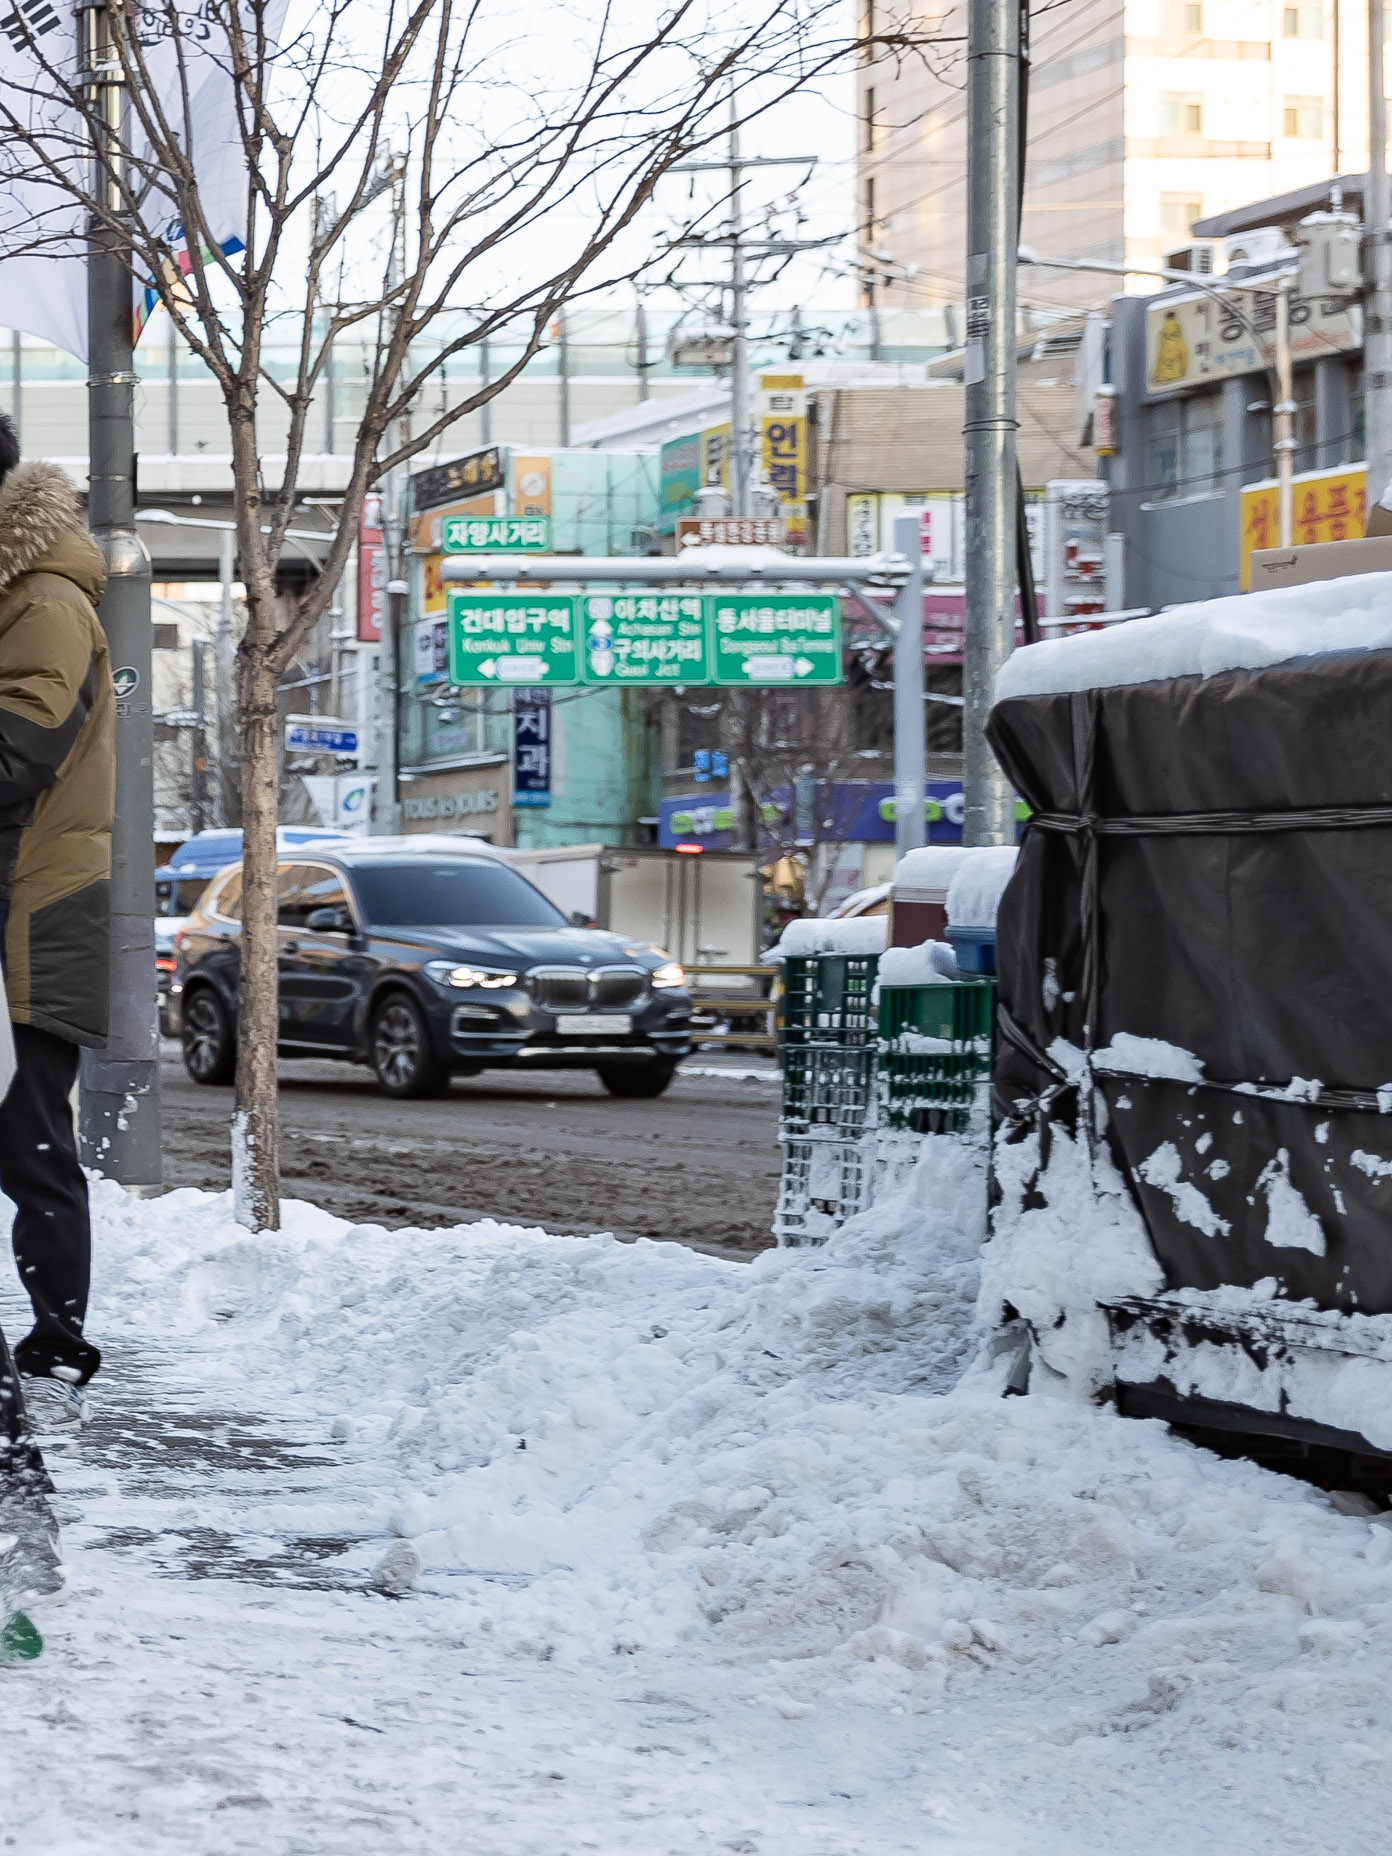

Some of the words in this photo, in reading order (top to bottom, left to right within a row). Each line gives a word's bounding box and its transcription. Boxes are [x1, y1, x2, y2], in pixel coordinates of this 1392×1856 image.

[448, 521, 545, 546] 자양사거리
[460, 607, 570, 633] 건대입구역
[614, 597, 702, 621] 아차산역
[716, 607, 832, 633] 동서울터미널
[613, 638, 702, 661] 구의사거리
